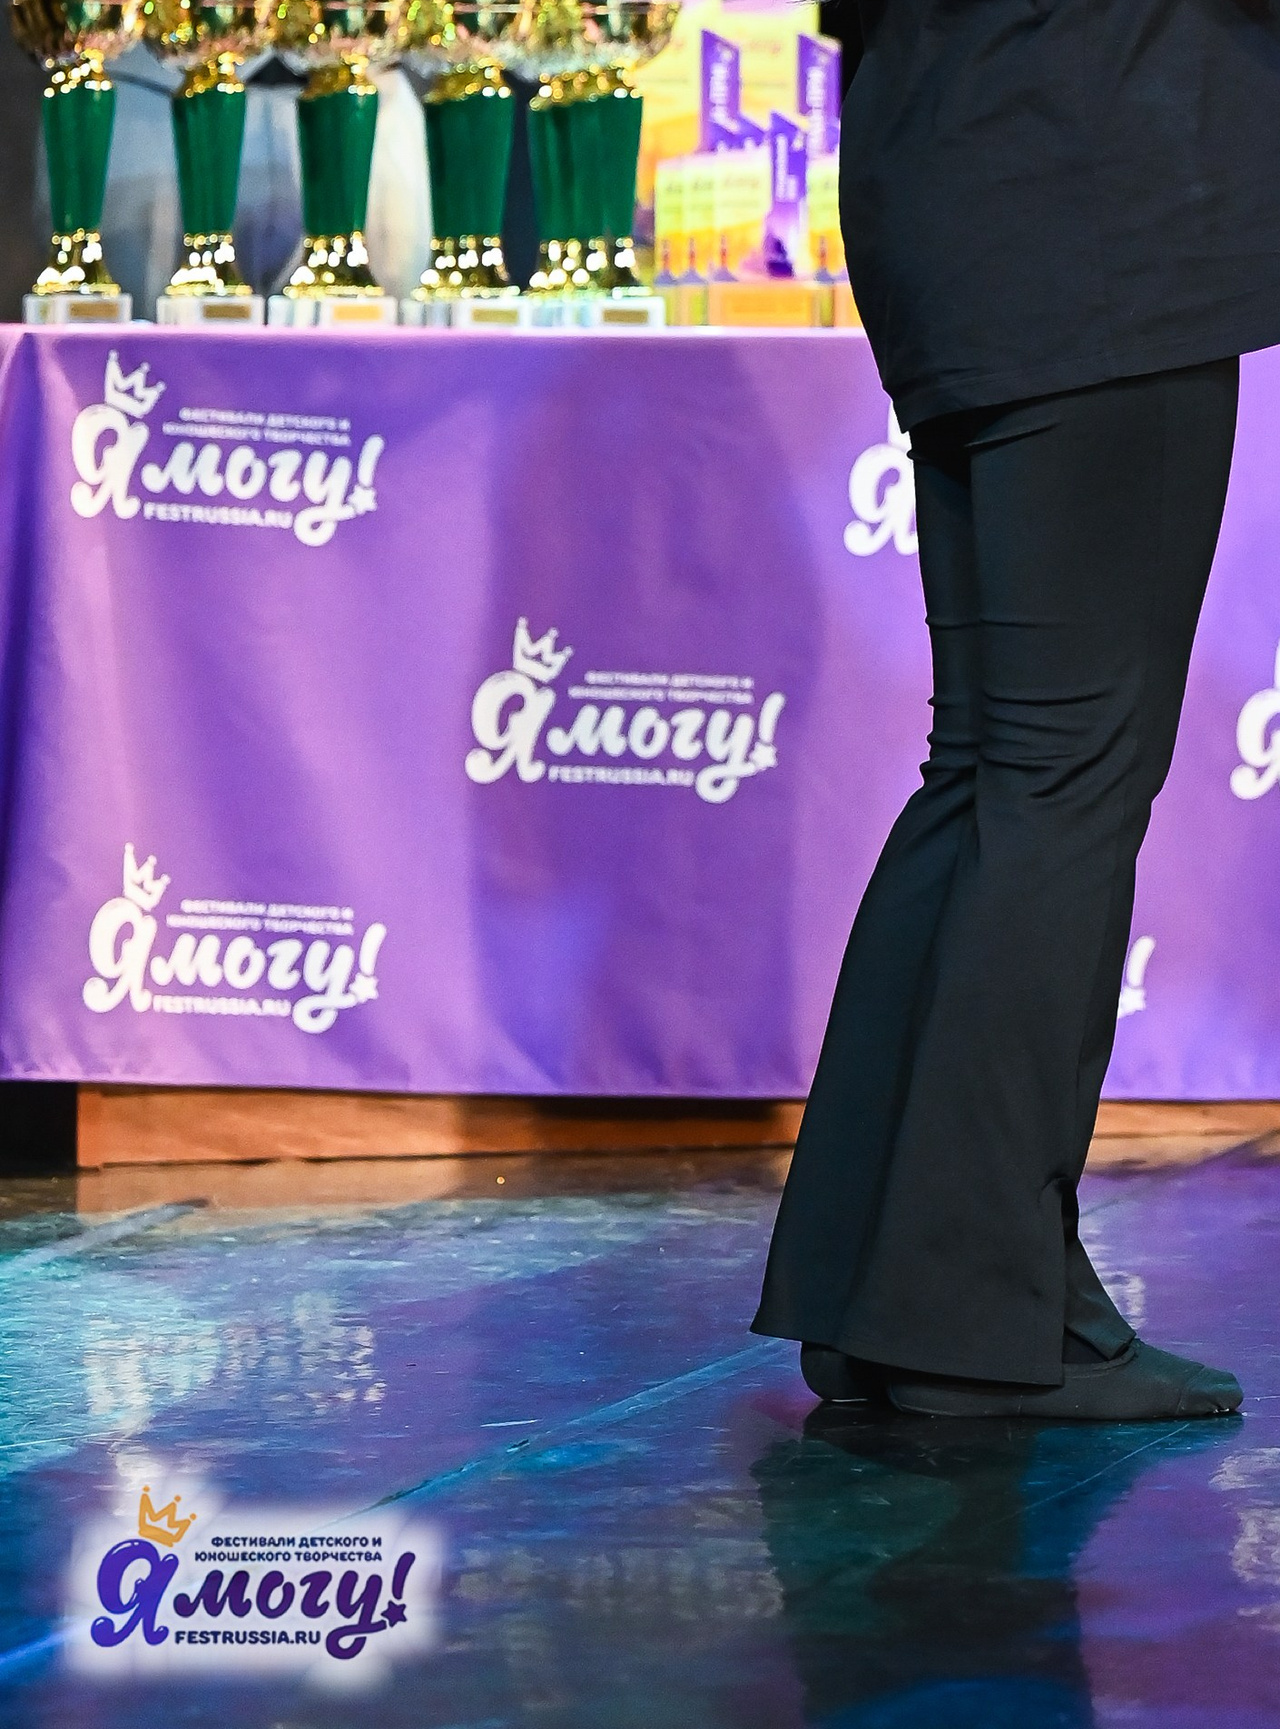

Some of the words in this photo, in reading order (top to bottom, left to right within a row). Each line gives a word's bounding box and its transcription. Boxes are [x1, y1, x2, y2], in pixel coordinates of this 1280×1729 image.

[70, 403, 149, 519] Я
[141, 434, 385, 547] могу!
[464, 670, 556, 784] Я
[546, 692, 786, 804] могу!
[82, 896, 157, 1013] Я
[150, 922, 387, 1034] могу!
